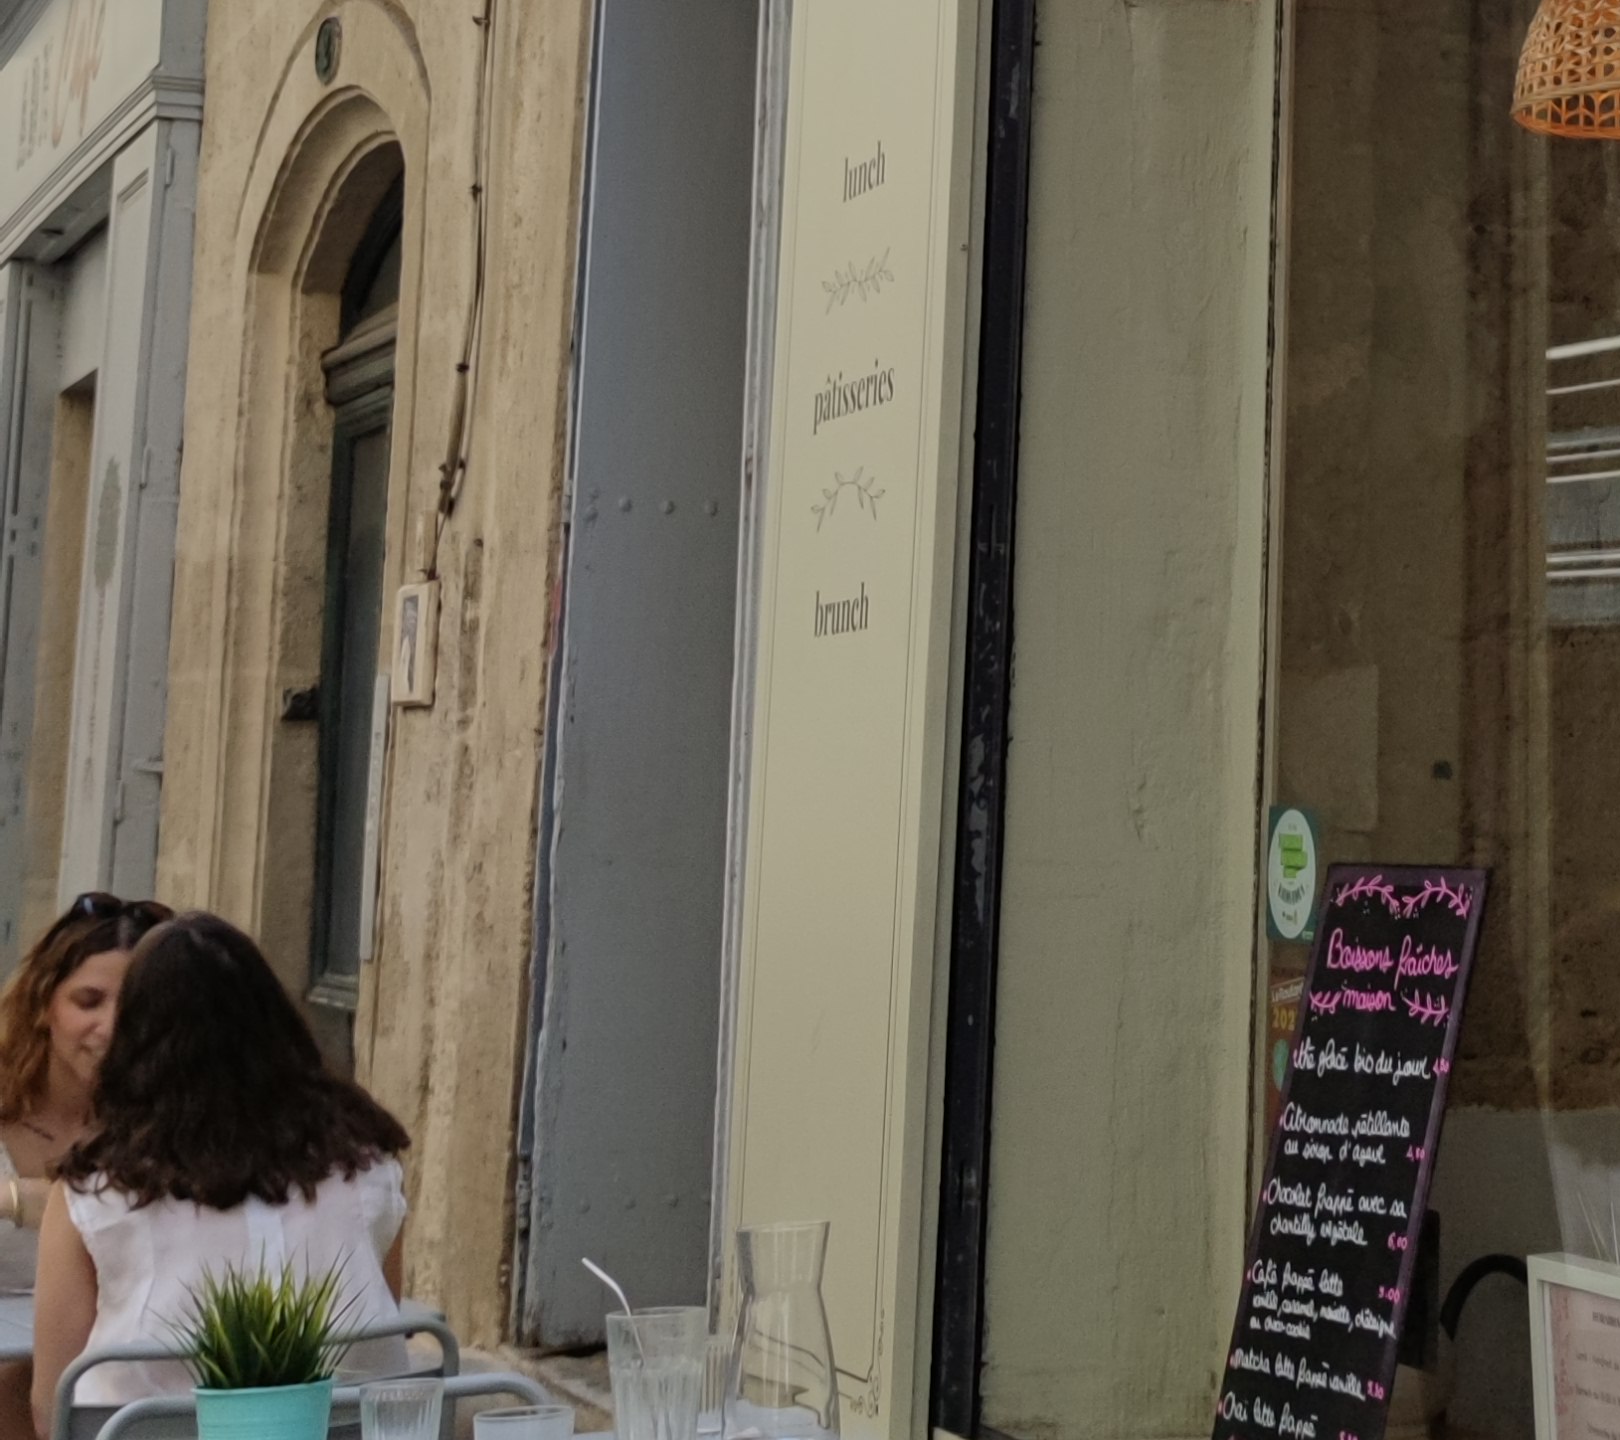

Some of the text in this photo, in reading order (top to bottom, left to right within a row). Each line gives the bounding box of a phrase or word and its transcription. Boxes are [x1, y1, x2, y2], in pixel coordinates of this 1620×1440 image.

[842, 139, 886, 204] lunch
[812, 357, 895, 437] pâtisseries
[813, 580, 870, 639] brunch
[1327, 927, 1393, 973] Boissons
[1342, 987, 1396, 1011] maison
[1354, 1042, 1374, 1073] bio
[1375, 1049, 1393, 1075] du
[1393, 1052, 1431, 1086] jour
[1284, 1139, 1298, 1155] au
[1302, 1138, 1333, 1163] sirop
[1267, 1176, 1312, 1208] Chocolat
[1358, 1195, 1387, 1214] avec
